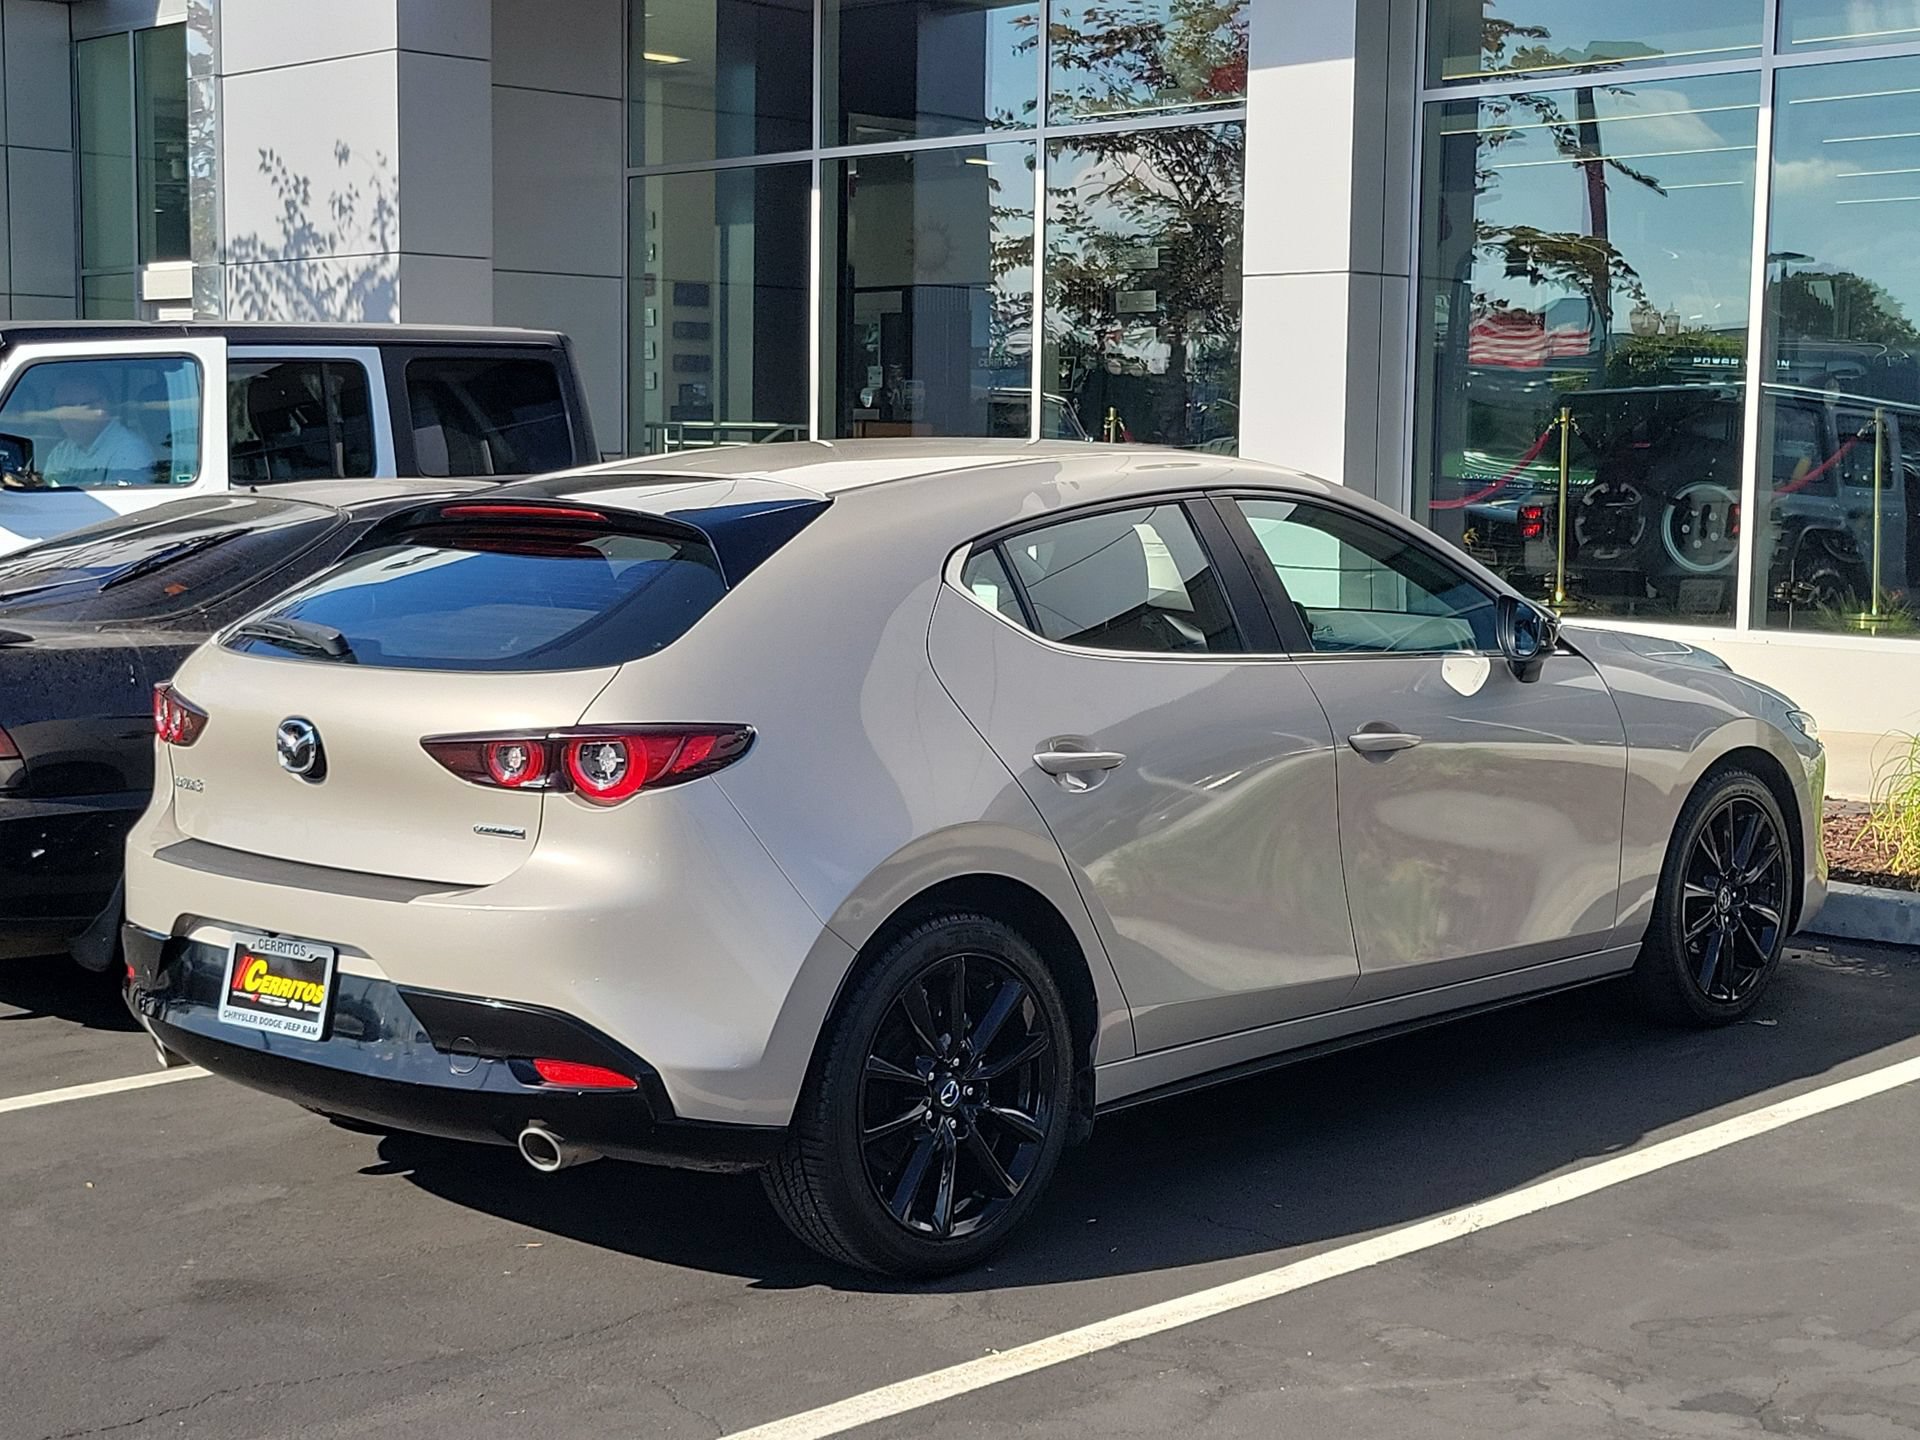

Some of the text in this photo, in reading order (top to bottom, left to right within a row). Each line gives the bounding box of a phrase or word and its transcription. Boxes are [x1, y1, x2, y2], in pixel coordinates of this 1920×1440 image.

[258, 938, 306, 957] CERRITOS
[223, 1009, 319, 1036] CHRYSLER DODGE JEEP RAM
